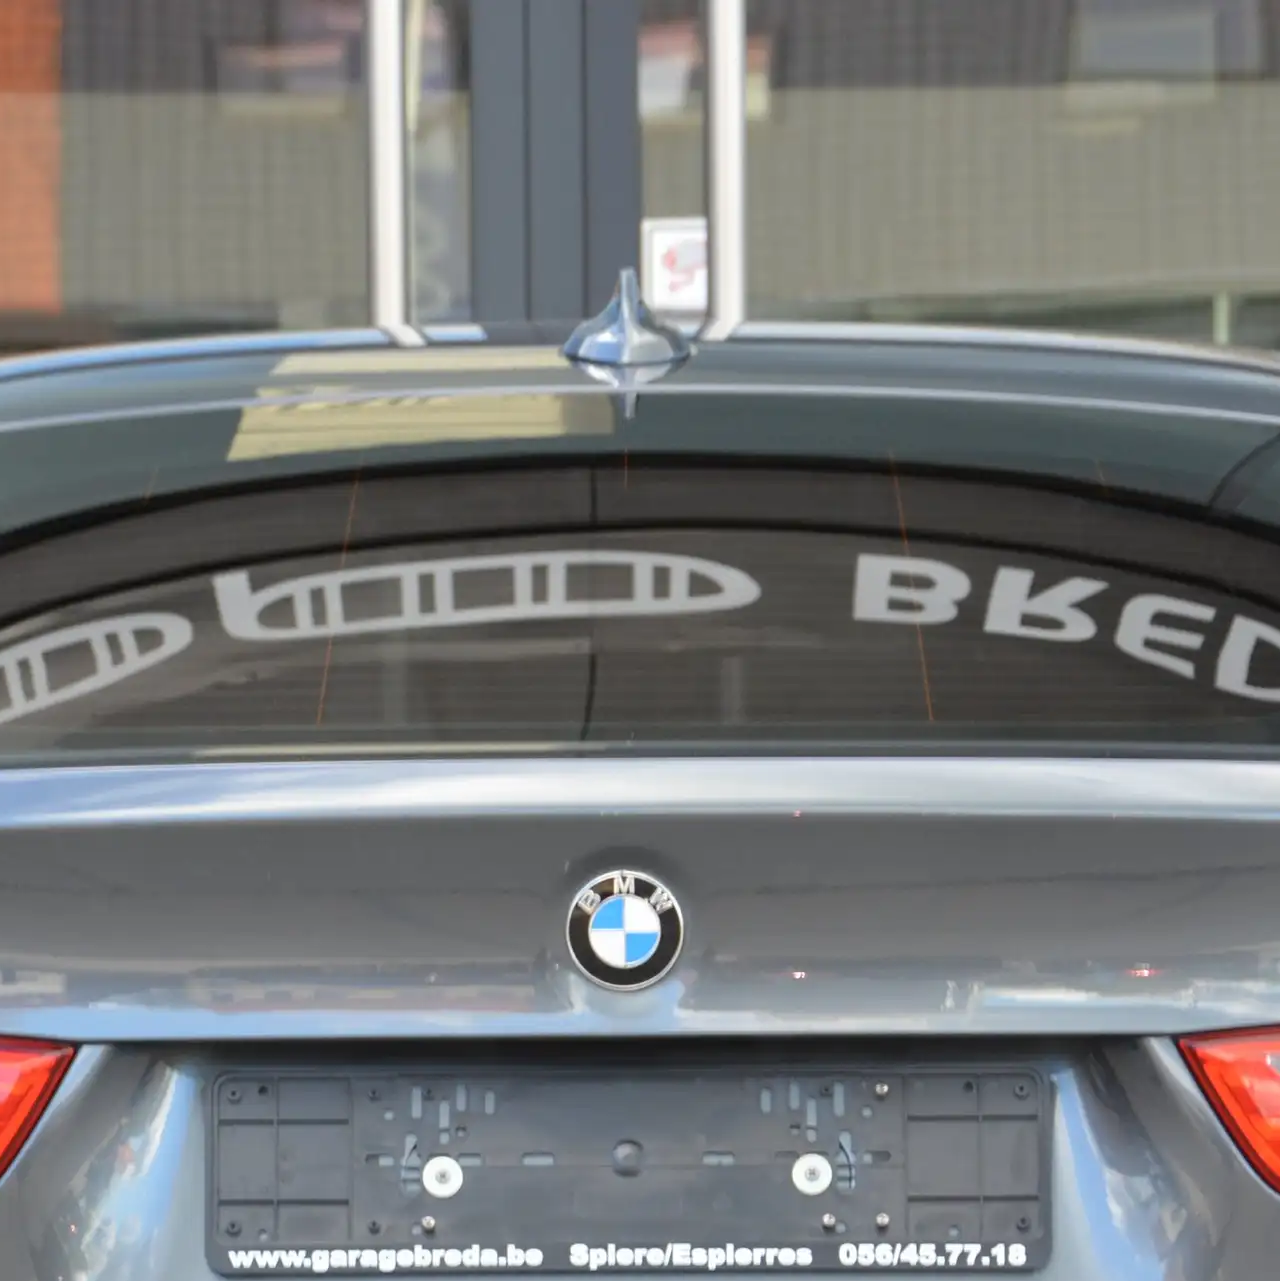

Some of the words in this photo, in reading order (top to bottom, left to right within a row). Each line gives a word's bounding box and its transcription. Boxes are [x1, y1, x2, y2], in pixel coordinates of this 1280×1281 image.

[577, 875, 673, 915] BMW
[228, 1244, 544, 1273] www.garagebreda.be
[838, 1243, 1027, 1266] 056/45.77.18
